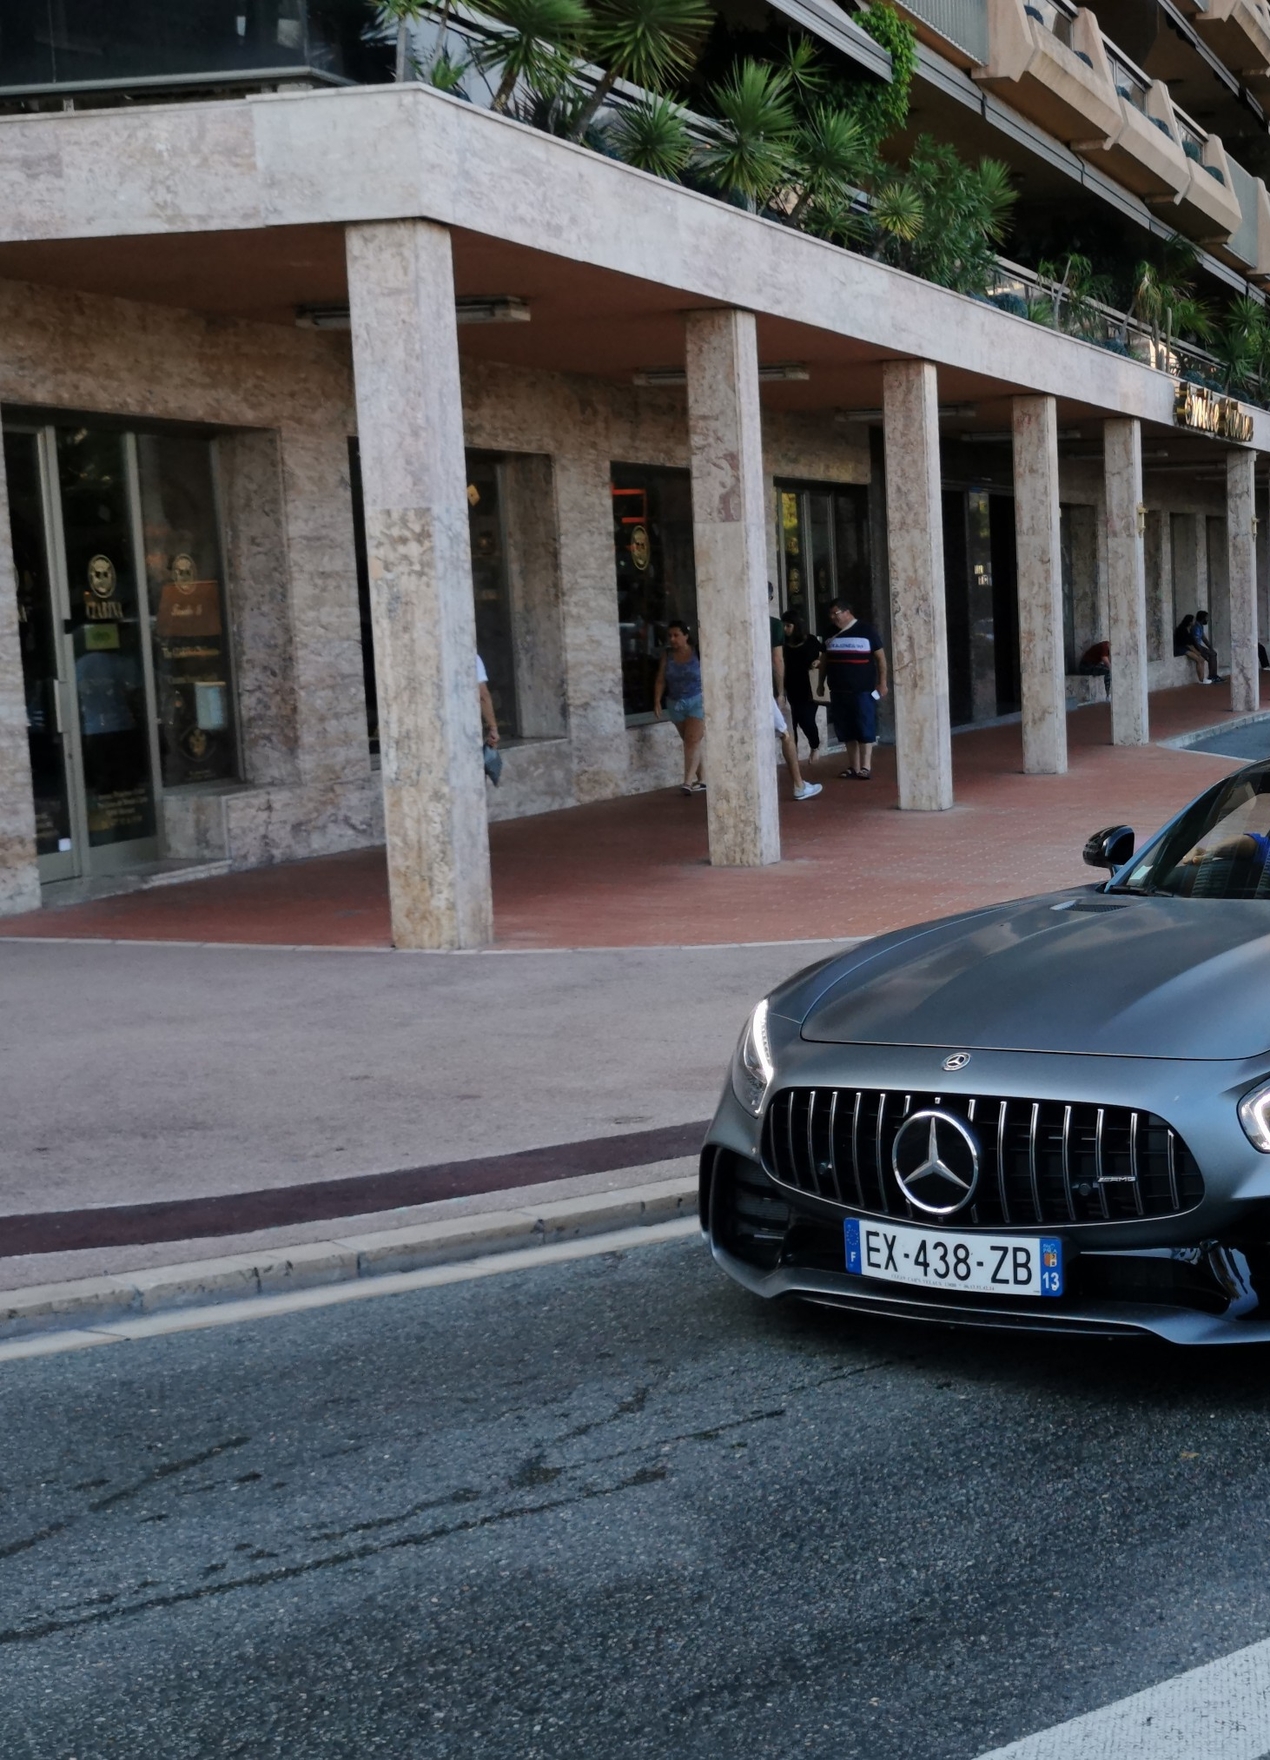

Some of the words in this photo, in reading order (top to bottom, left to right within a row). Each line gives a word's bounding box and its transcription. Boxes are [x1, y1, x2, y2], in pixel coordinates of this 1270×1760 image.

[850, 1251, 857, 1262] F
[866, 1230, 1032, 1285] EX-438-ZB
[1042, 1271, 1060, 1291] 13
